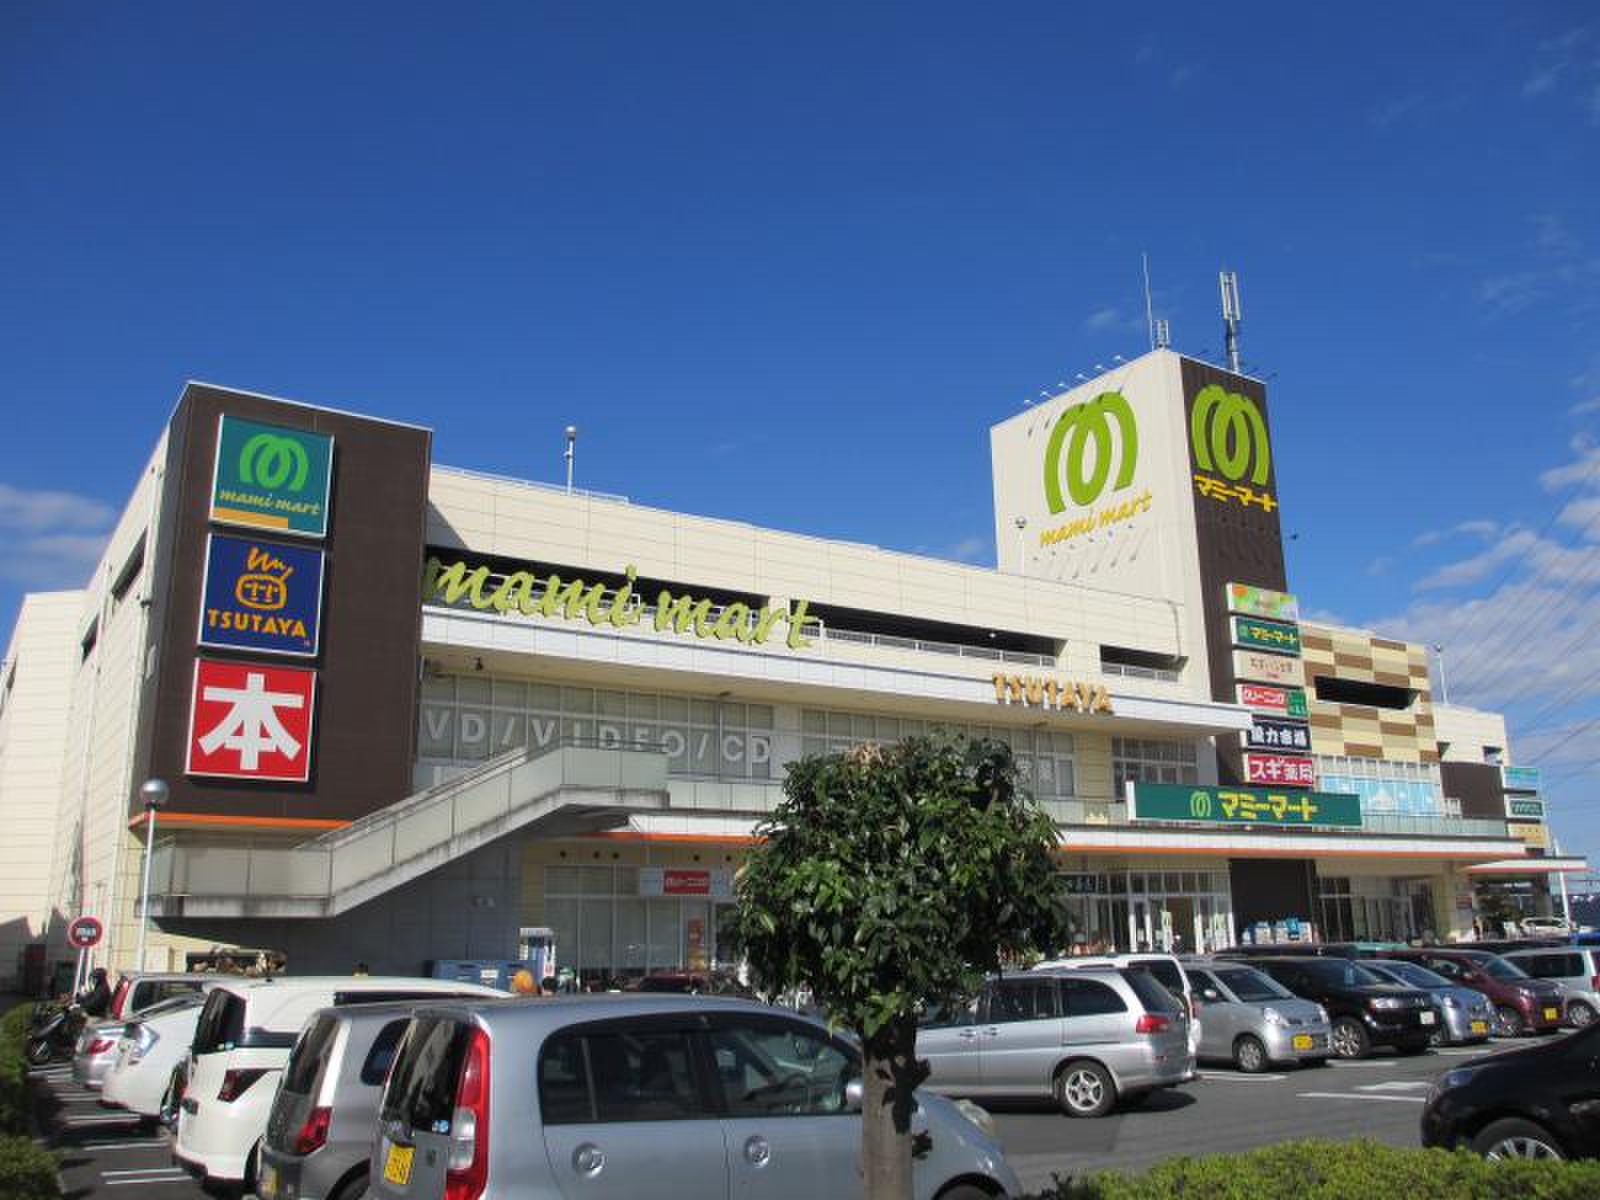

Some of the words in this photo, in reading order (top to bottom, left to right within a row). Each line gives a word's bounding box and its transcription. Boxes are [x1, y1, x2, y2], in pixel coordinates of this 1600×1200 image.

[219, 489, 275, 509] mami
[275, 498, 321, 515] mart
[1193, 474, 1277, 513] マミーマート
[1040, 508, 1096, 547] mami
[1099, 488, 1152, 527] mart
[207, 608, 307, 637] TSUTAYA
[424, 560, 641, 626] mami
[655, 590, 823, 650] mart
[992, 672, 1114, 713] TSUTAYA
[199, 673, 304, 770] 本
[1217, 792, 1318, 822] マミーマート
